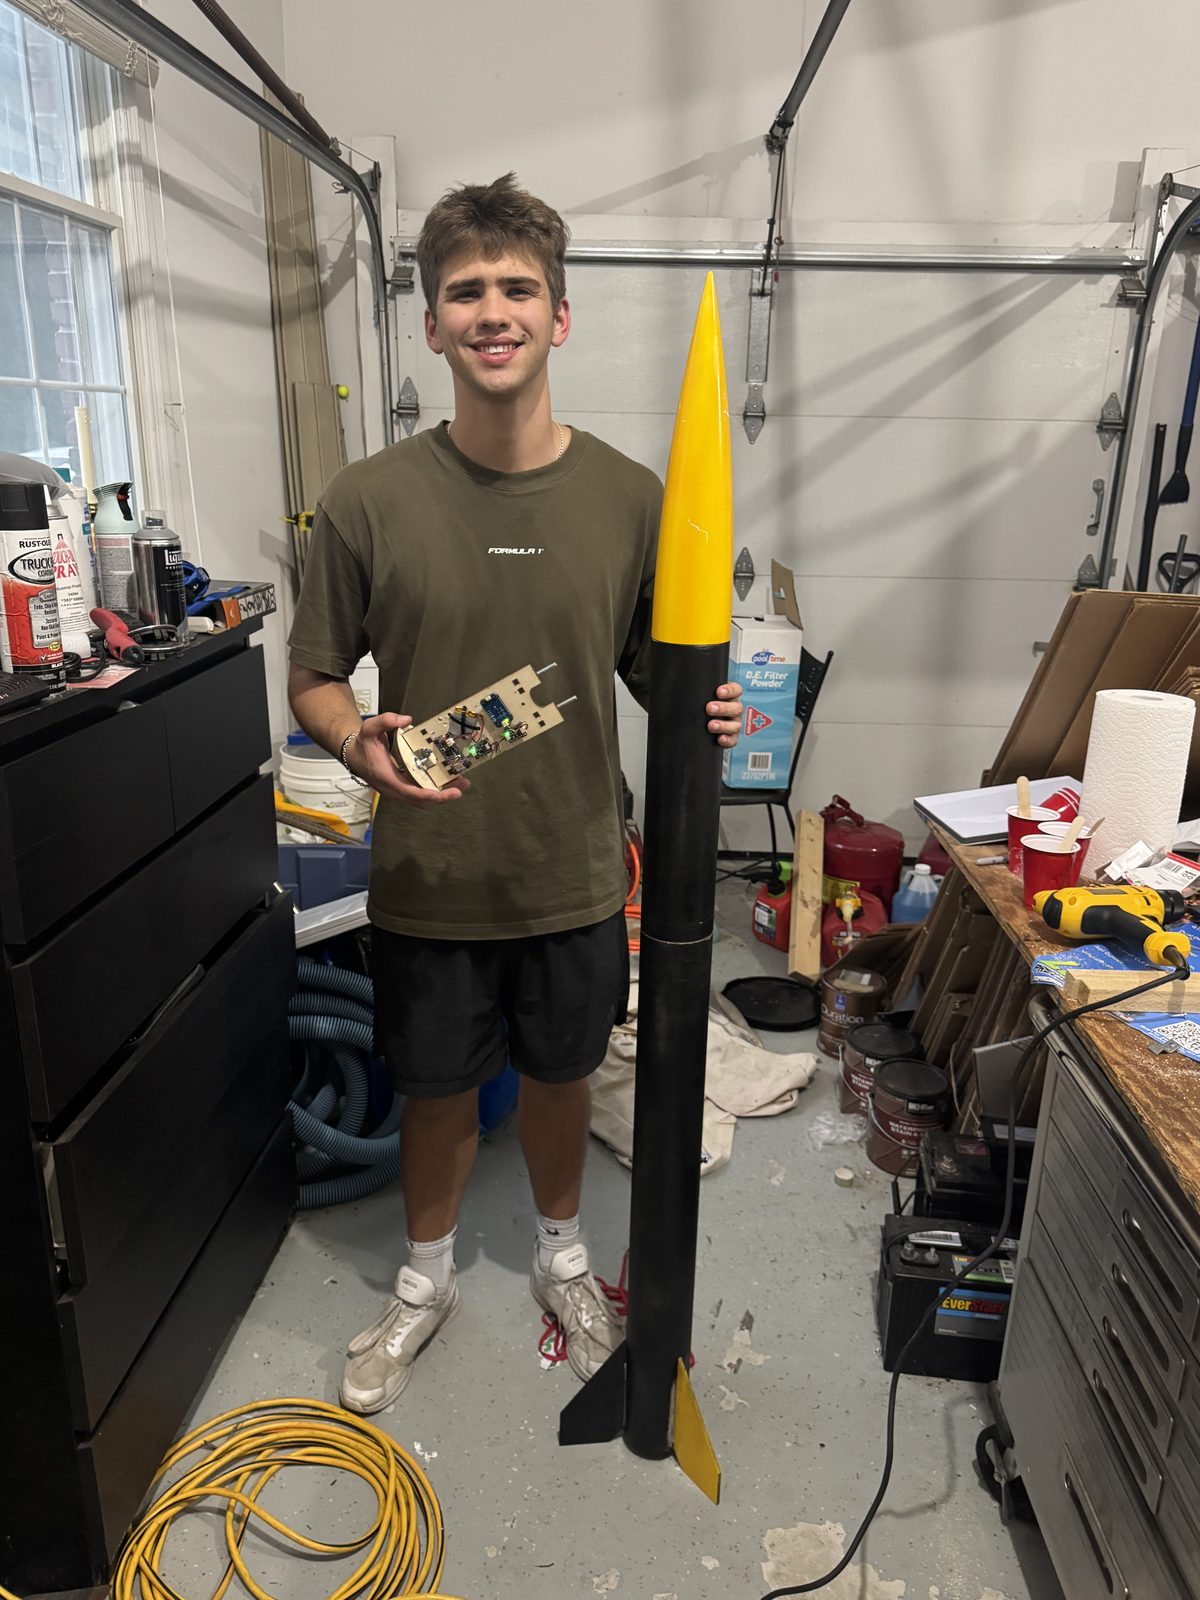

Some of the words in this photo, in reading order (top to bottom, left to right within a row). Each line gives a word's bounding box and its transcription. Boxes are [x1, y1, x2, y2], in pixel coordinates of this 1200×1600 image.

[488, 547, 536, 555] FORMULA
[764, 671, 789, 680] Filter
[751, 679, 785, 688] Powder
